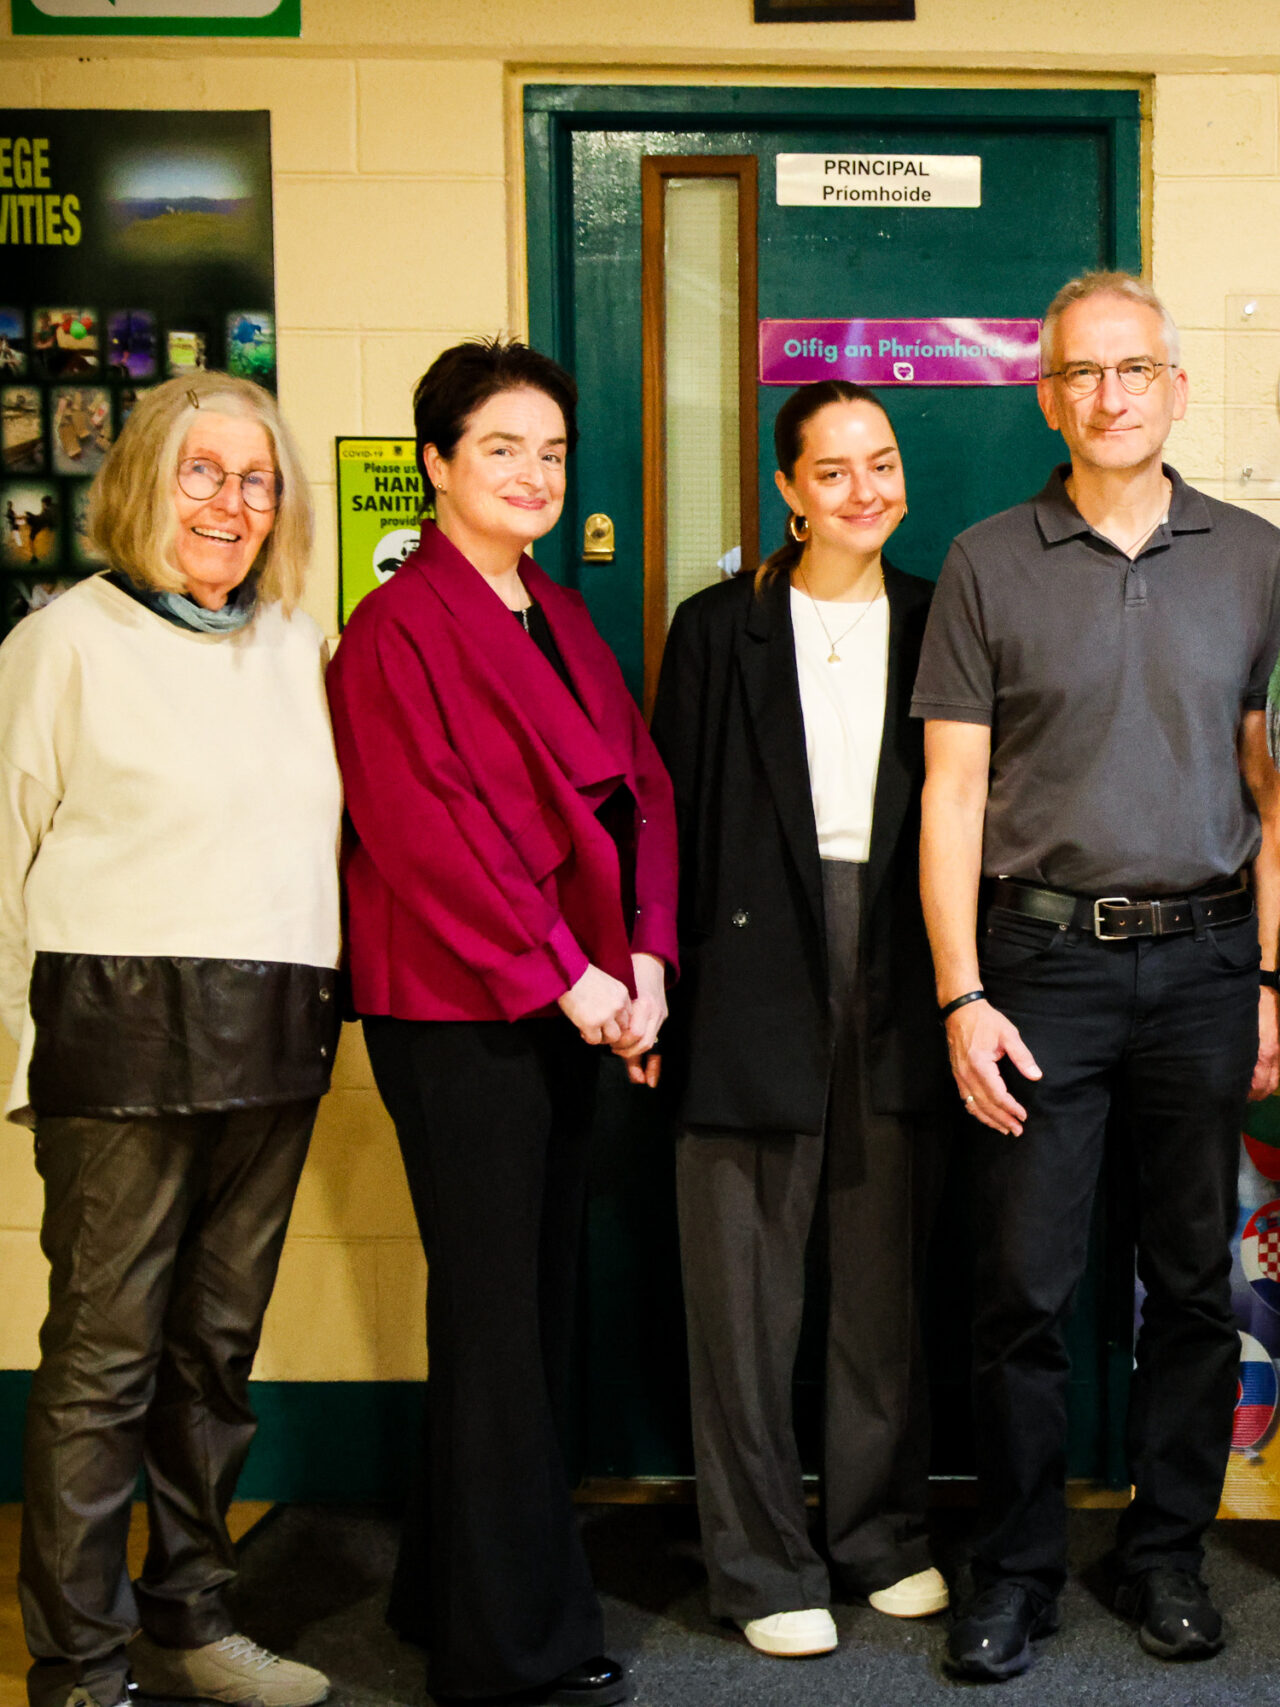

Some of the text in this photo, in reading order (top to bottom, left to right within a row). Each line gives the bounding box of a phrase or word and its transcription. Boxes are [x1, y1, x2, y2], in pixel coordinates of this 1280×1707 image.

[824, 160, 930, 176] PRINCIPAL
[783, 338, 838, 363] Oifig
[844, 344, 872, 358] an
[364, 462, 418, 473] Please us
[375, 477, 419, 492] HAN
